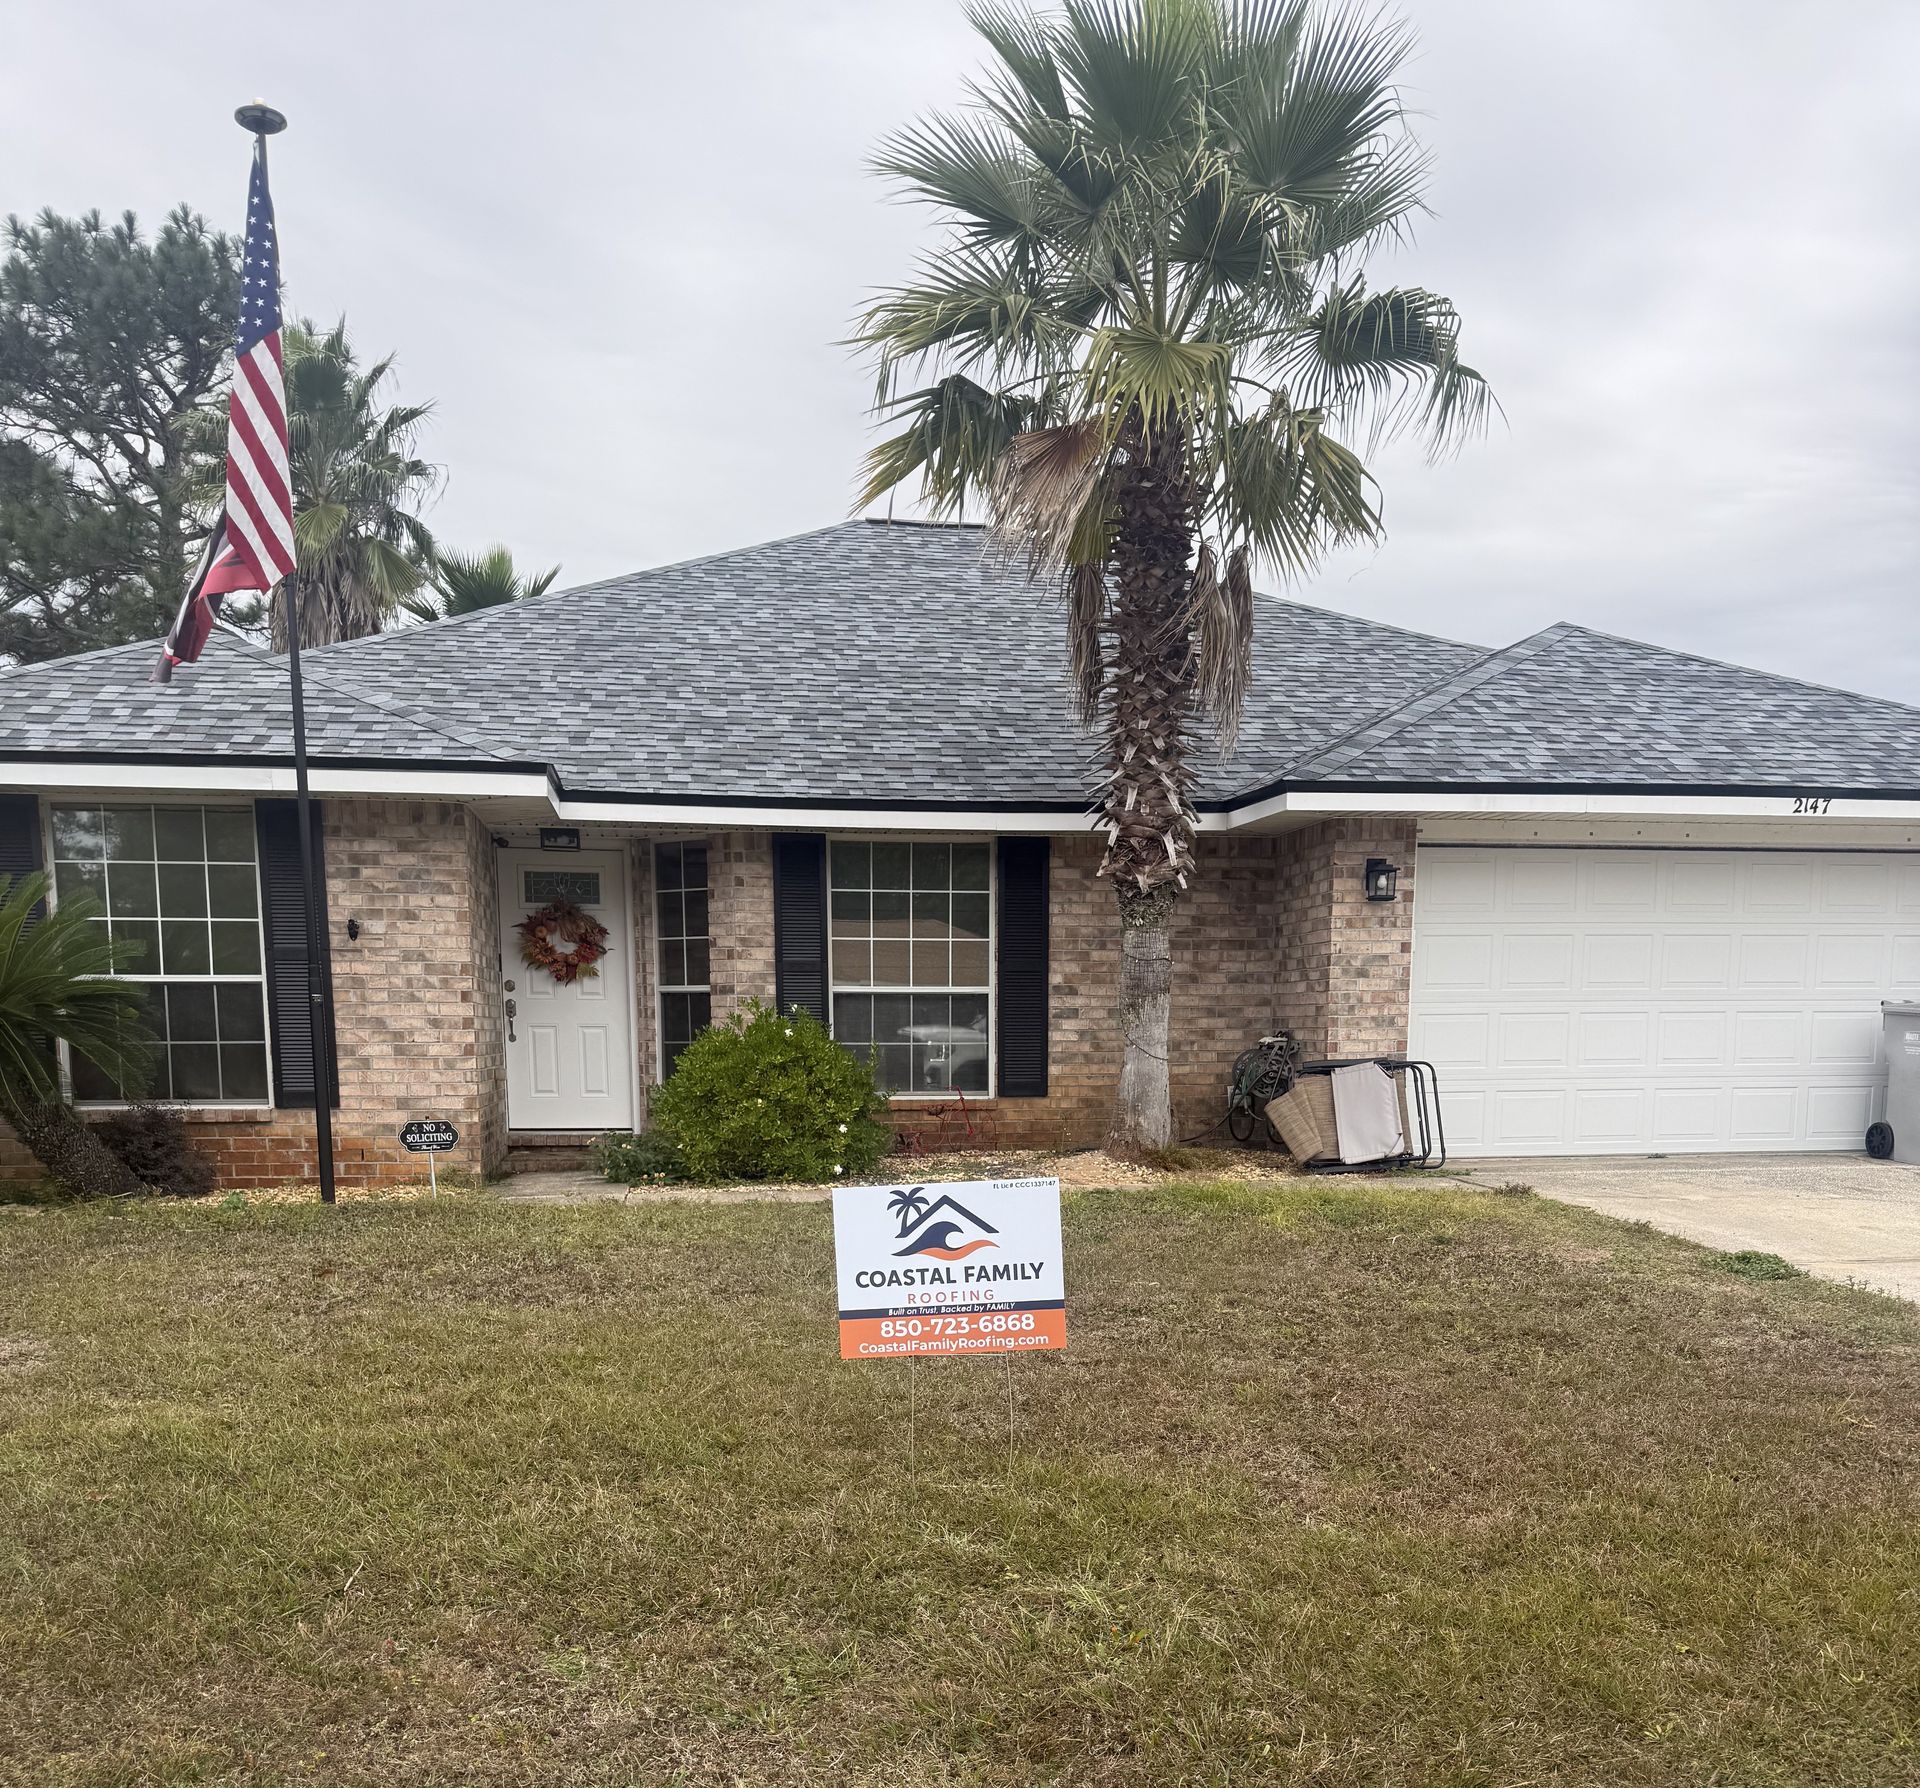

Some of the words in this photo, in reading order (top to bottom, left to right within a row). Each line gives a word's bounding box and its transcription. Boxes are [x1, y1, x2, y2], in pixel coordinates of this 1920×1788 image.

[1792, 797, 1832, 814] 2147
[422, 1123, 436, 1132] NO
[406, 1132, 453, 1143] SOLICITING
[855, 1267, 957, 1289] COASTAL
[964, 1262, 1045, 1283] FAMILY
[907, 1289, 994, 1304] ROOFING
[920, 1307, 938, 1315] Trust,
[941, 1304, 971, 1313] Backed
[974, 1304, 985, 1312] by
[986, 1302, 1015, 1311] FAMILY
[880, 1314, 1035, 1338] 850-723-6868
[859, 1334, 1049, 1354] CoastalFamilyRoofing.com
